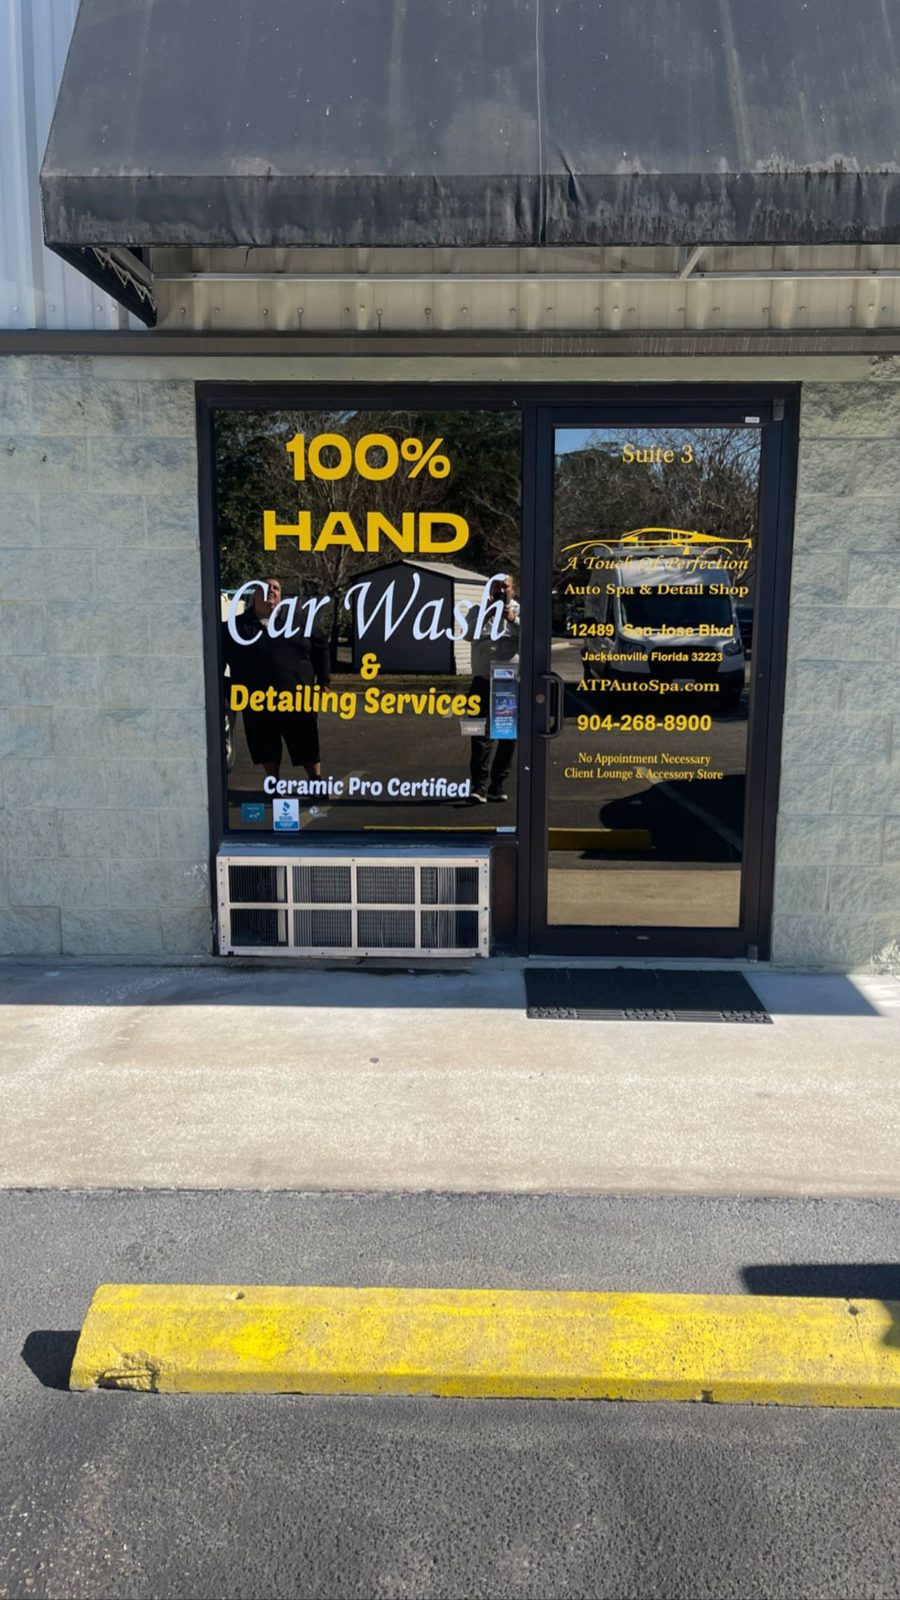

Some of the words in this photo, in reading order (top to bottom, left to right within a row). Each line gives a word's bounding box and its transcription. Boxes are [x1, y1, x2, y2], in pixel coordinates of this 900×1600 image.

[286, 433, 451, 481] 100%
[622, 444, 674, 463] Suite
[681, 444, 693, 463] 3
[263, 510, 470, 553] HAND
[561, 557, 577, 572] A
[584, 557, 634, 570] Touch
[665, 556, 749, 574] Perfection
[565, 583, 600, 595] Auto
[606, 583, 634, 596] Spa
[639, 583, 651, 595] &
[657, 583, 703, 595] Detail
[709, 583, 749, 597] Shop
[227, 579, 331, 646] Car
[344, 572, 507, 643] Wash
[570, 623, 614, 637] 12489
[623, 624, 652, 637] San
[657, 624, 694, 637] Jose
[699, 624, 734, 637] Blvd
[582, 652, 648, 661] Jacksonville
[651, 652, 689, 661] Florida
[691, 652, 723, 662] 32223
[360, 653, 381, 681] &
[576, 679, 720, 694] ATPAutoSpa.com
[230, 684, 357, 720] Detailing
[364, 687, 482, 716] Services
[577, 714, 712, 731] 904-268-8900
[578, 753, 592, 764] No
[594, 752, 658, 766] Appointment
[661, 753, 711, 767] Necessary
[564, 768, 594, 779] Client
[597, 768, 633, 781] Lounge
[635, 768, 644, 779] &
[647, 768, 694, 782] Accessory
[697, 769, 723, 780] Store
[263, 776, 343, 796] Ceramic
[348, 778, 383, 796] Pro
[387, 778, 471, 798] Certified
